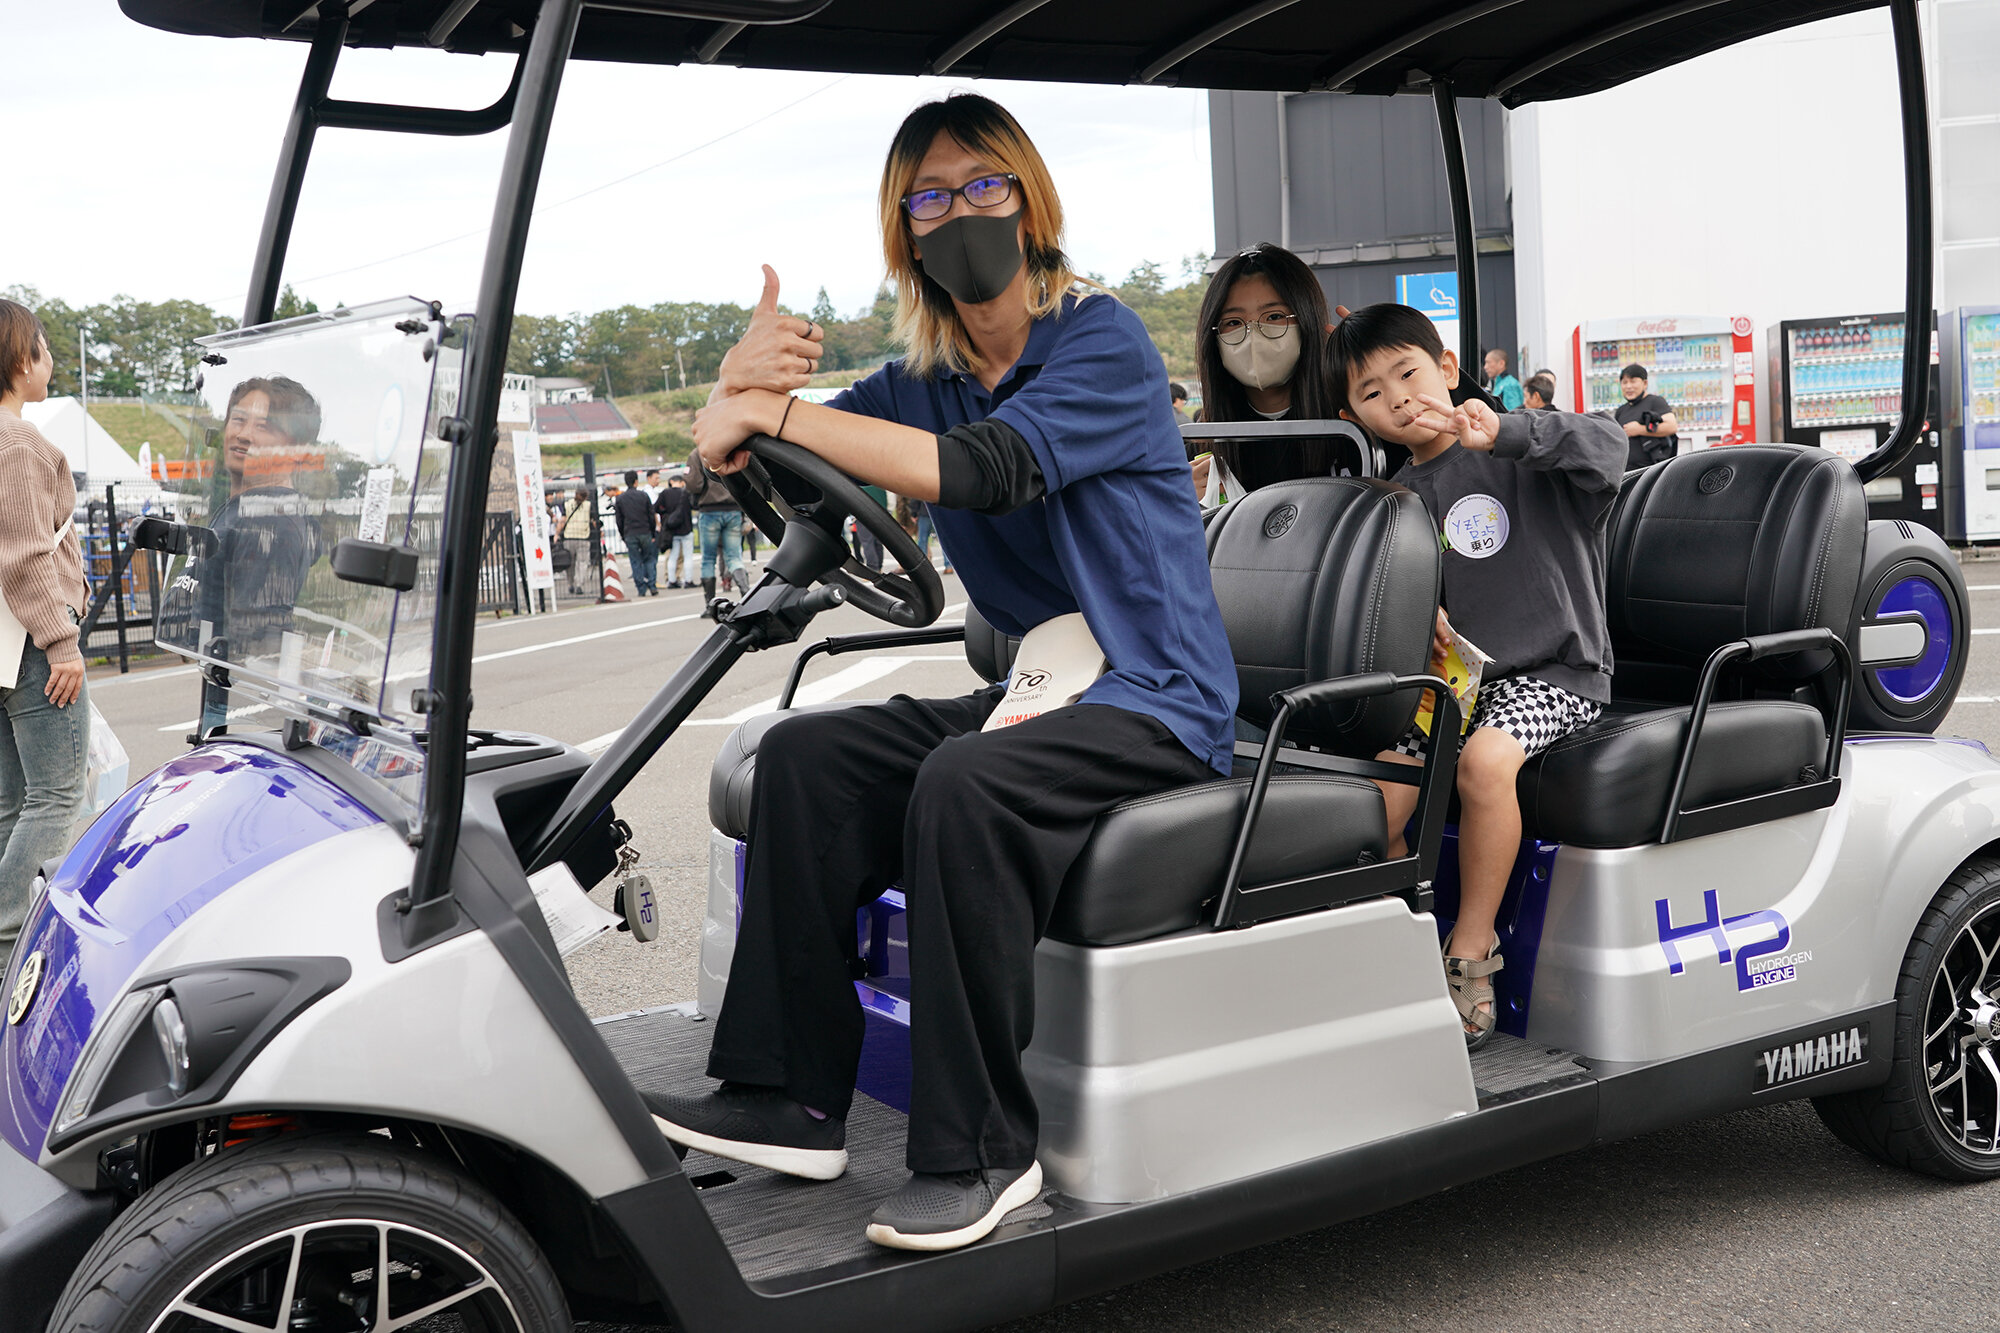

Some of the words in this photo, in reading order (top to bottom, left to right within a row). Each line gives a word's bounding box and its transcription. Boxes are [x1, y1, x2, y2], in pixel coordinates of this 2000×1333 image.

[1471, 538, 1494, 552] 乗り
[640, 891, 653, 925] H2
[1654, 888, 1792, 993] H2
[1751, 950, 1813, 975] HYDROGEN
[1752, 966, 1795, 987] ENGINE
[1763, 1027, 1863, 1084] YAMAHA
